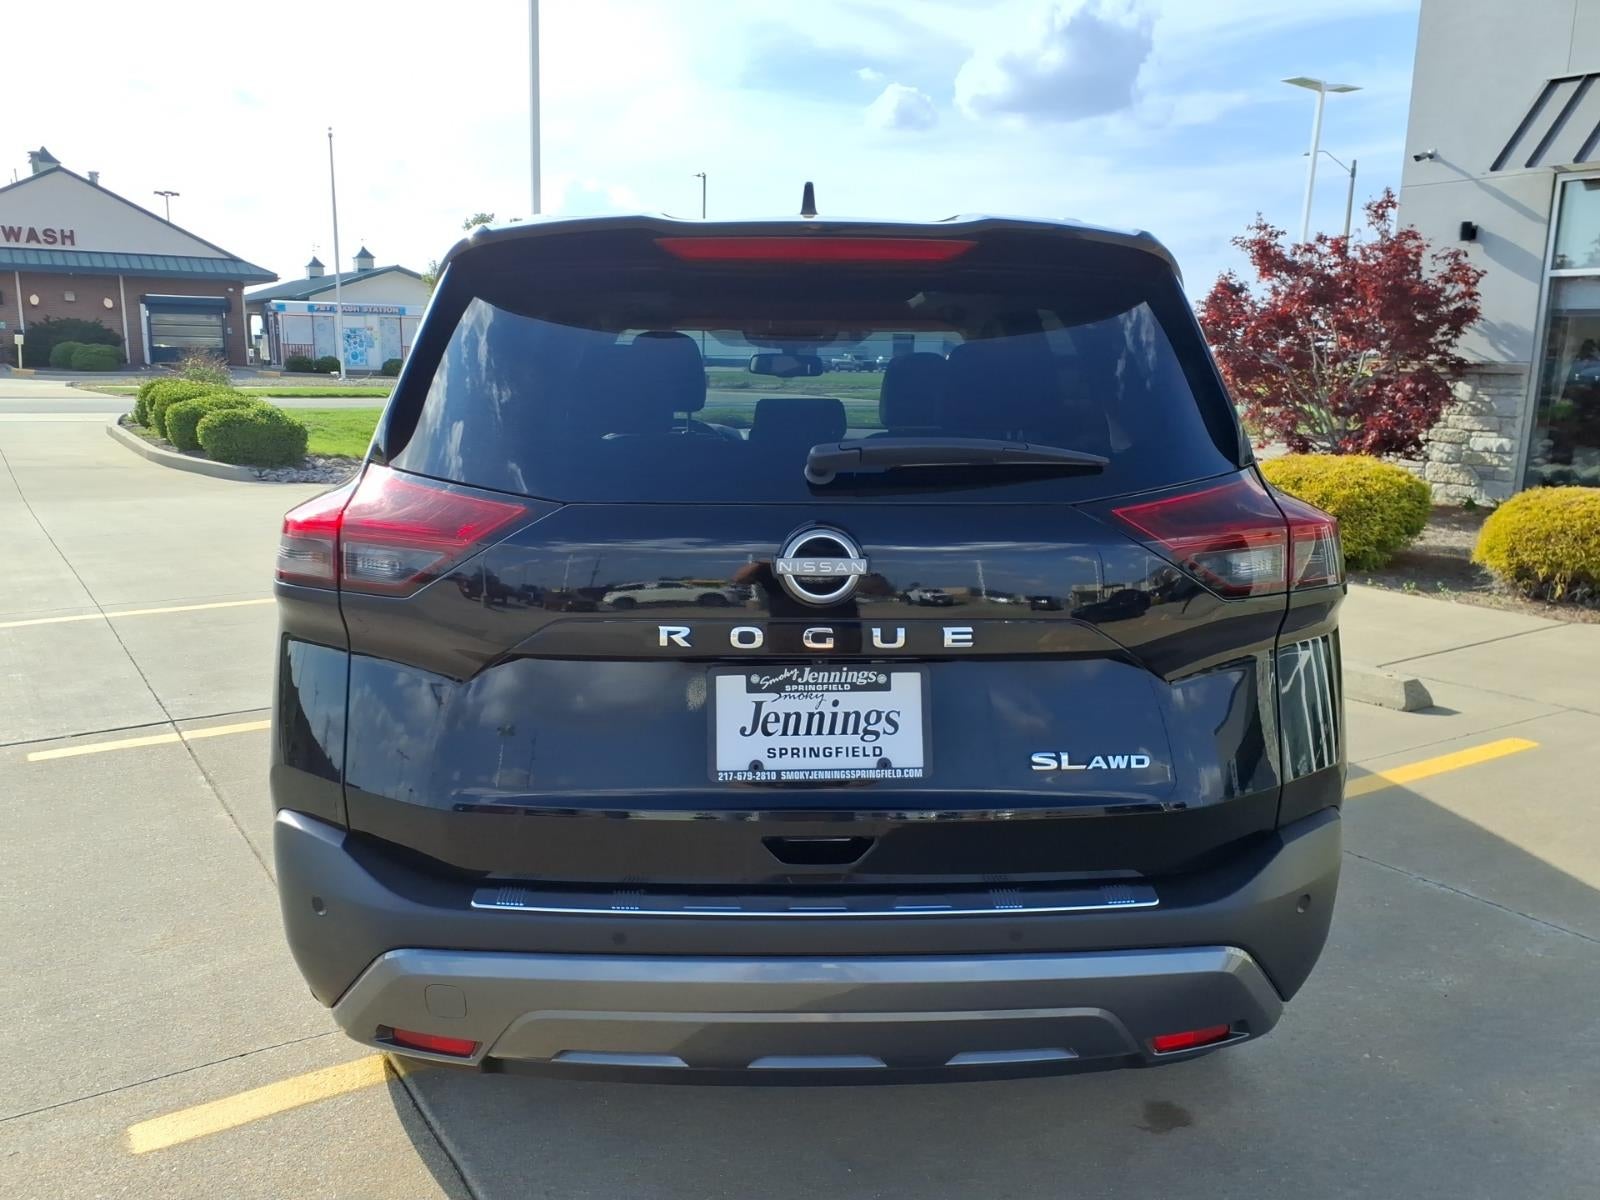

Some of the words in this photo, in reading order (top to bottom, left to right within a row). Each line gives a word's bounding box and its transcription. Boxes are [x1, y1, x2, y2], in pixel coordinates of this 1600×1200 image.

[0, 225, 76, 246] WASH
[363, 304, 400, 314] STATION
[779, 561, 864, 573] NISSAN
[658, 625, 975, 649] ROGUE
[760, 668, 799, 690] Smoky
[798, 667, 878, 685] Jennings
[739, 699, 901, 742] Jennings
[766, 746, 883, 759] SPRINGFIELD
[1031, 752, 1087, 770] SL
[1087, 755, 1150, 769] AWD
[780, 768, 923, 780] SMOKYJENNINGSSPRINGFIELD.COM
